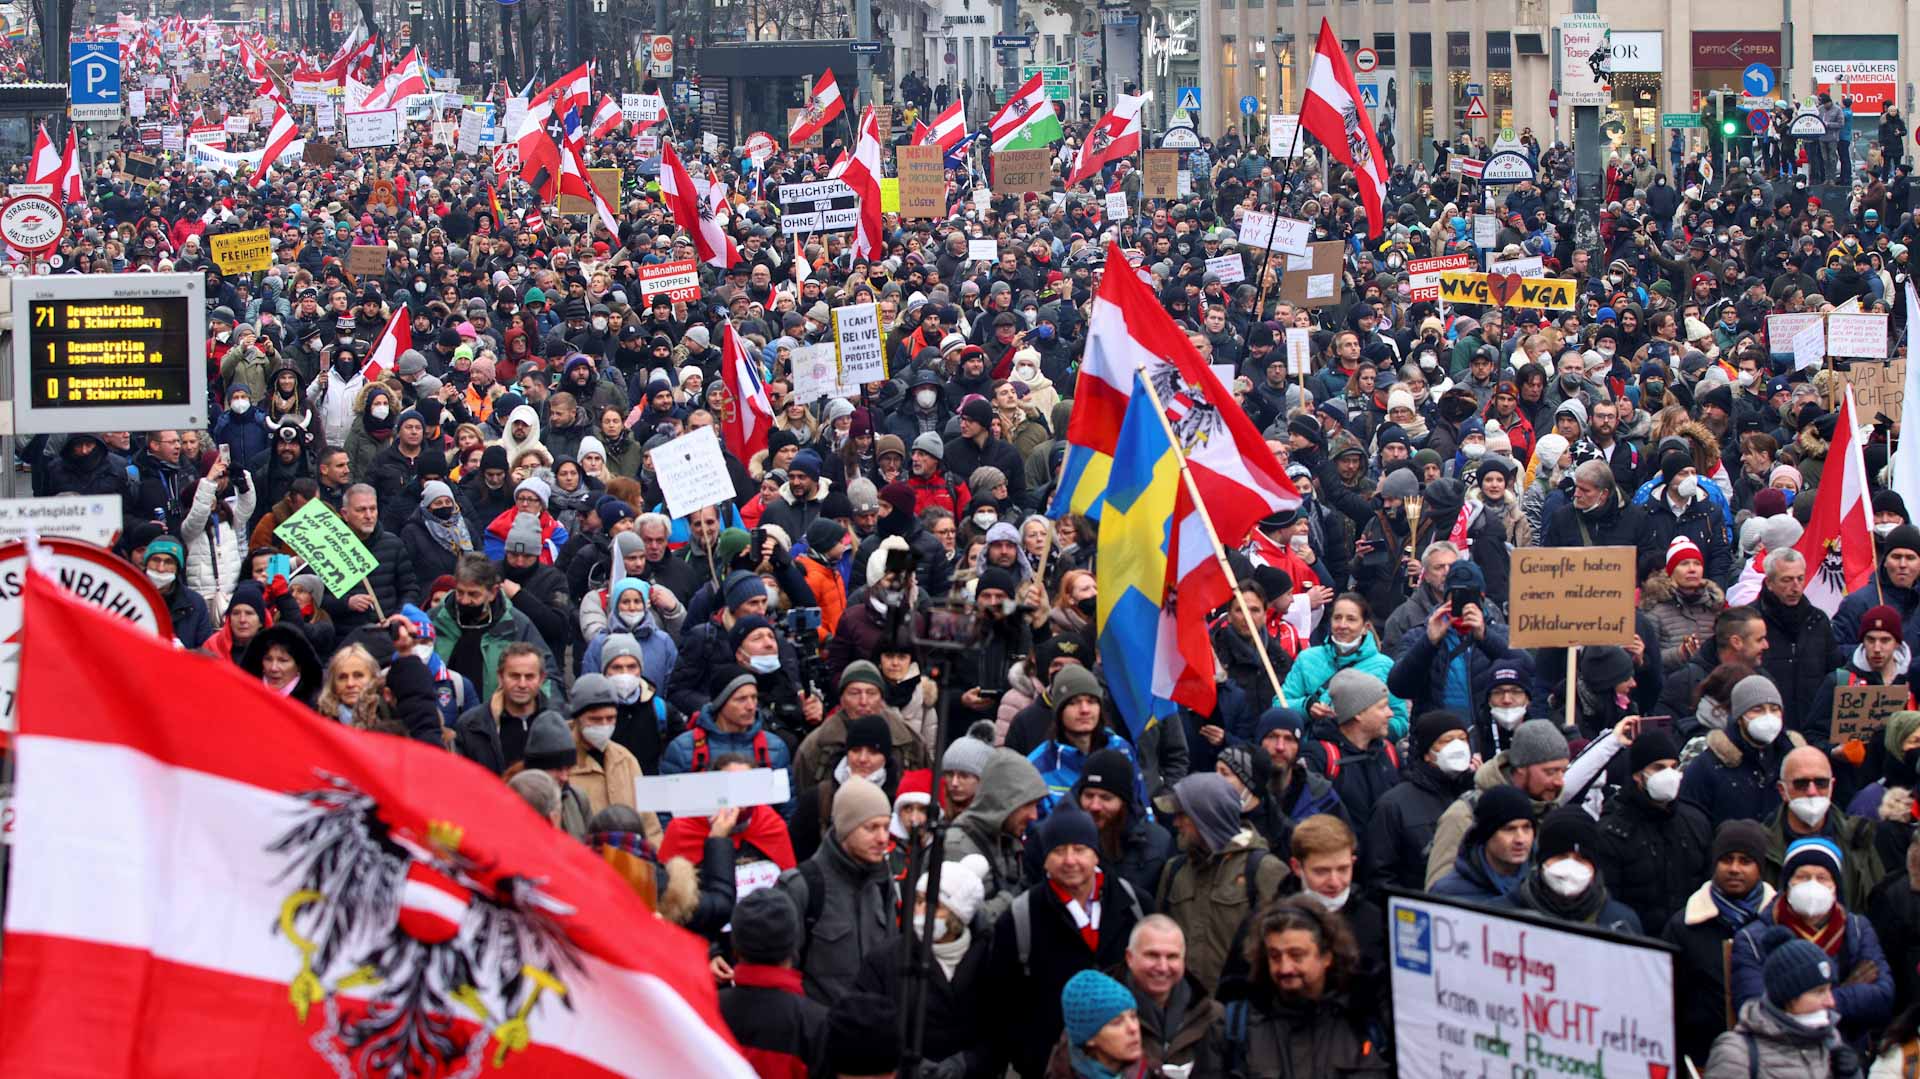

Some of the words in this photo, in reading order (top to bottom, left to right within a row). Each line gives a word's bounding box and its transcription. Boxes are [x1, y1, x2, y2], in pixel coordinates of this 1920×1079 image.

[1699, 45, 1727, 54] OPTIC
[1743, 45, 1775, 54] OPERA
[1814, 62, 1896, 72] ENGEL&VÖLKERS
[623, 96, 639, 107] FÜR
[642, 99, 657, 108] DIE
[623, 111, 657, 120] FREIHEIT
[1494, 155, 1524, 166] AUTOBUS
[781, 183, 851, 199] PFLICHTSTIC
[5, 201, 59, 221] STRASSENBAHN
[816, 200, 830, 210] ???
[783, 217, 814, 228] OHNE
[1248, 214, 1263, 225] MY
[8, 228, 57, 244] HALTESTELLE
[1244, 228, 1261, 240] MY
[642, 262, 693, 278] Maßnahmen
[1409, 256, 1468, 273] GEMEINSAM
[649, 276, 690, 290] STOPPEN
[151, 288, 181, 296] Minuten
[1413, 287, 1438, 300] FRE
[35, 306, 55, 328] 71
[66, 304, 144, 317] Demonstration
[67, 318, 80, 329] ab
[84, 316, 162, 329] Schwarzenberg
[842, 328, 878, 343] BELIVE
[47, 342, 56, 363] 1
[67, 340, 145, 353] Demonstration
[150, 352, 163, 364] ab
[845, 349, 880, 362] PROTEST
[68, 375, 146, 389] Demonstration
[69, 388, 81, 400] ab
[85, 387, 163, 401] Schwarzenberg
[18, 505, 87, 519] Karlsplatz
[302, 513, 321, 530] von
[282, 520, 346, 585] Kindern
[348, 546, 372, 573] weg
[1520, 556, 1576, 579] Geimpfte
[1583, 556, 1621, 572] haben
[1520, 585, 1555, 601] einen
[1564, 584, 1622, 599] milderen
[1518, 613, 1627, 634] Diktaturverlauf
[1434, 915, 1471, 960] Die
[1482, 923, 1556, 992] Impfung
[1485, 1001, 1519, 1028] uns
[1522, 992, 1600, 1045] NICHT
[1602, 1016, 1666, 1061] retten
[1474, 1021, 1511, 1058] mehr
